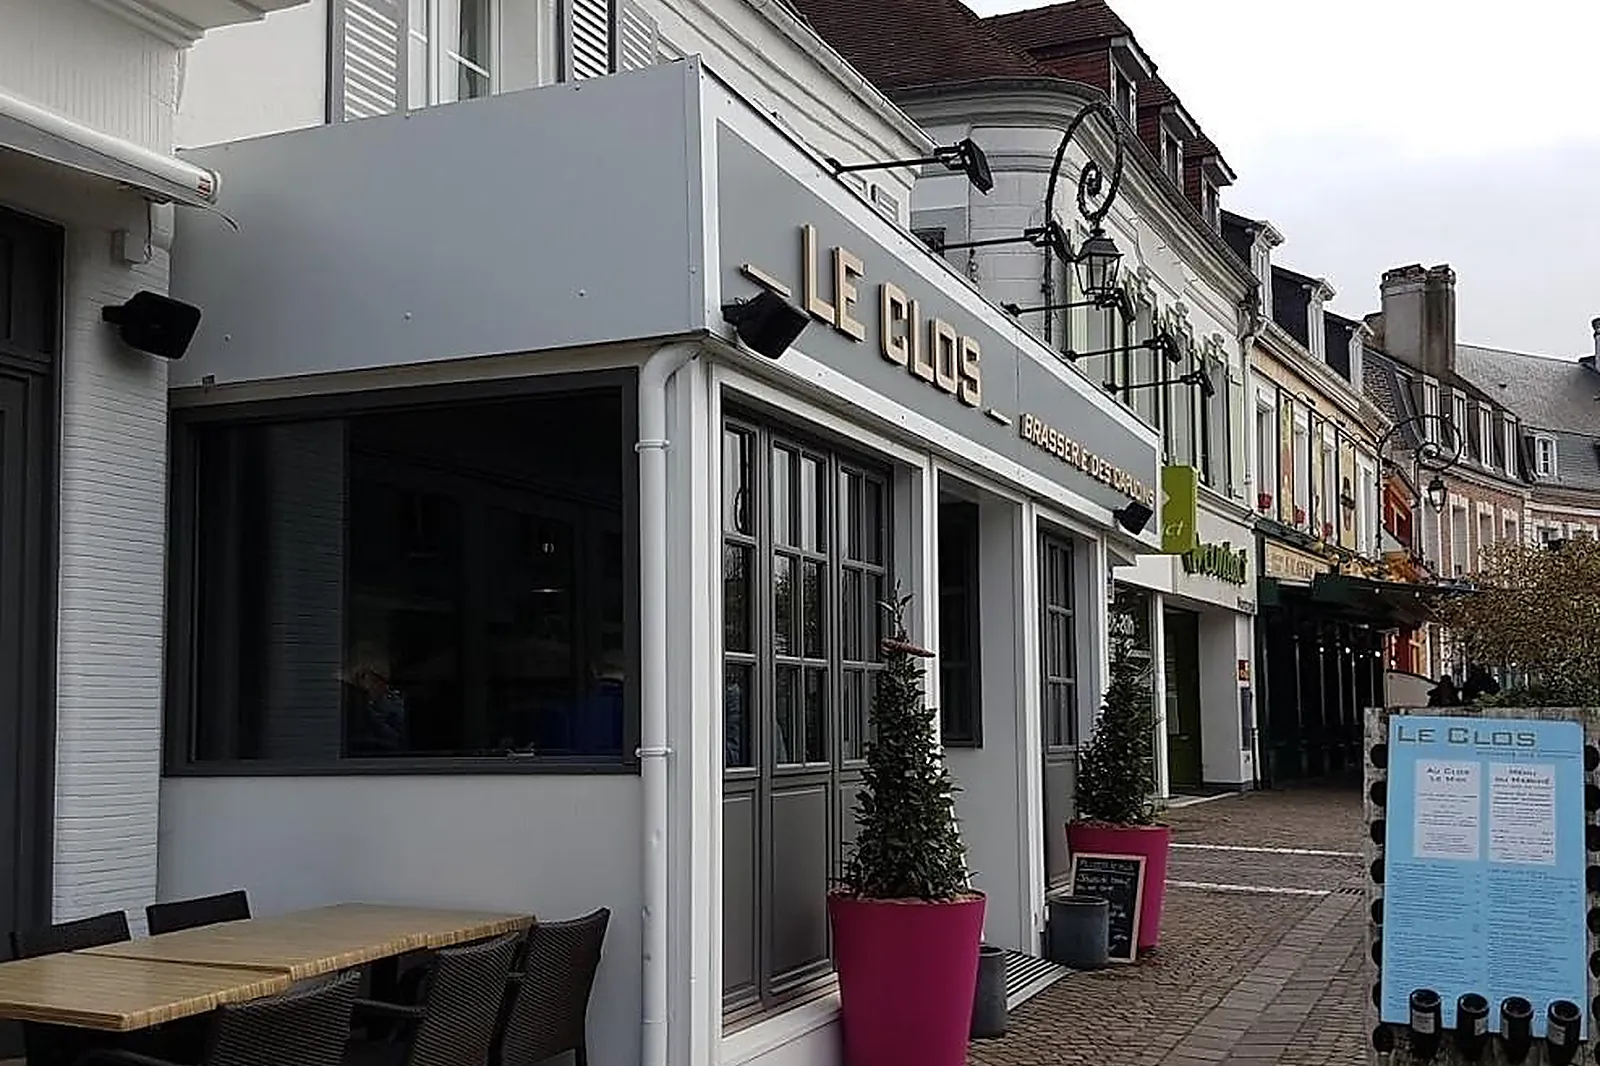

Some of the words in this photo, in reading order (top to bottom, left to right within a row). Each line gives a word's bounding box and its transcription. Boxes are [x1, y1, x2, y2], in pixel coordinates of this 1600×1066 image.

[802, 223, 866, 342] LE
[879, 281, 981, 408] CLOS
[1397, 725, 1437, 743] LE
[1448, 727, 1537, 747] CLOS
